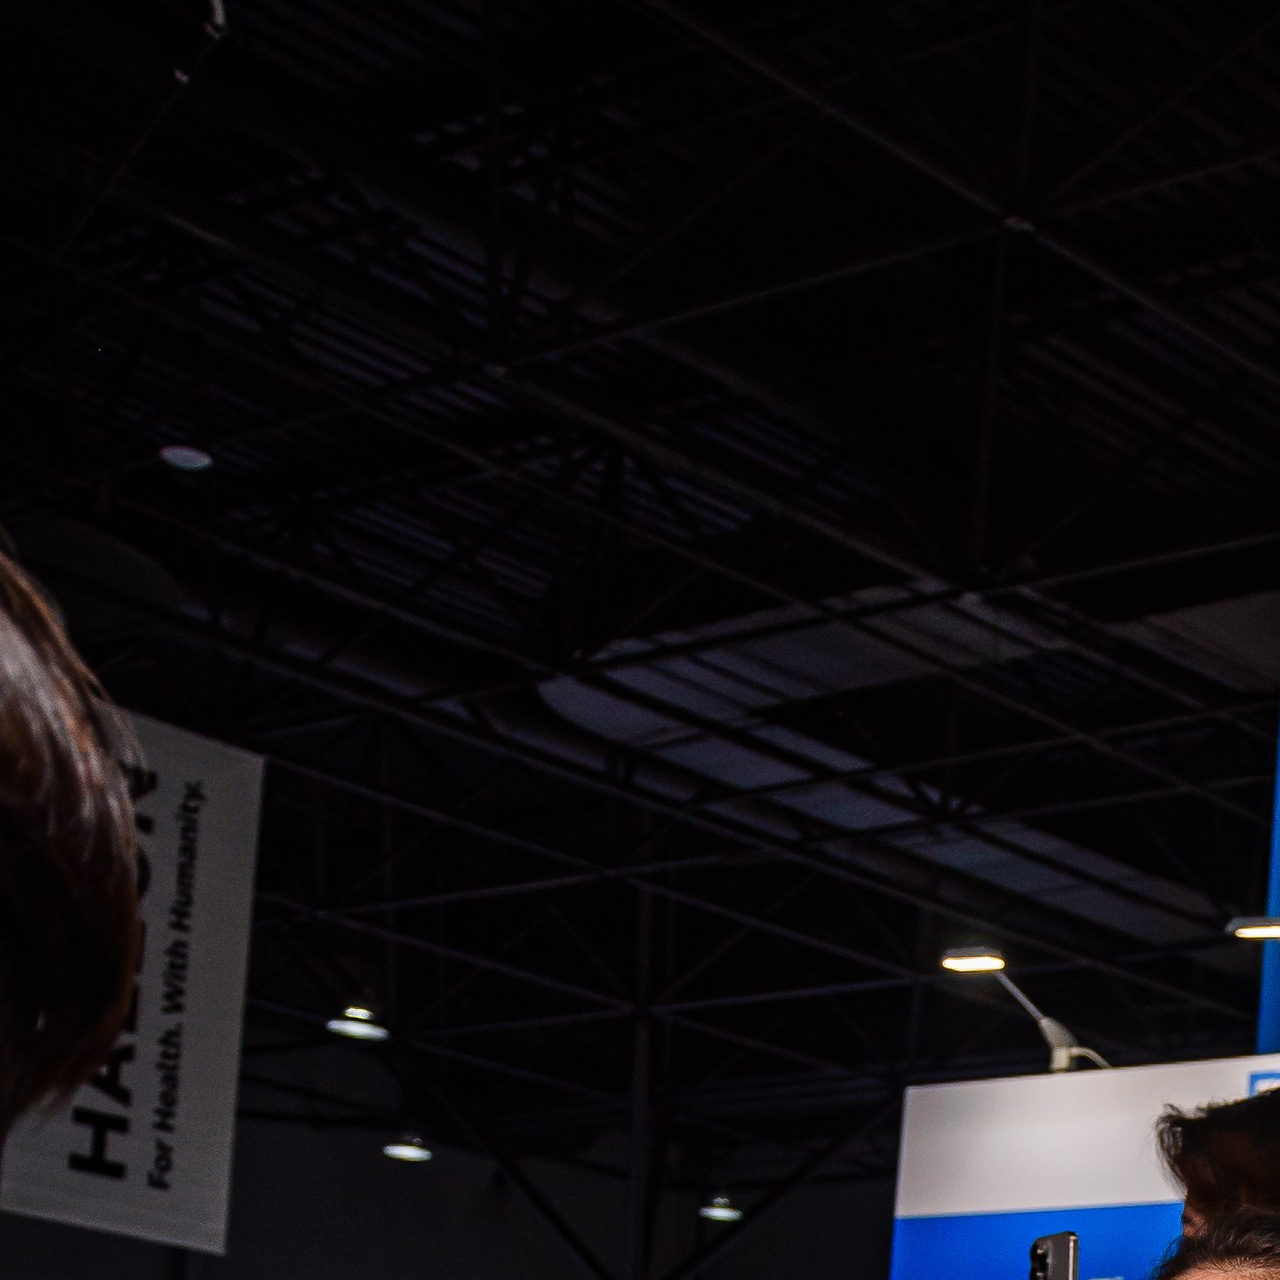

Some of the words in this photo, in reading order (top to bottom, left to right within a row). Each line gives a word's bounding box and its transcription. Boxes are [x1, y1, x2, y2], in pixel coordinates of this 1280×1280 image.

[161, 937, 189, 1016] With
[153, 1022, 183, 1134] Health.
[147, 1138, 174, 1191] For
